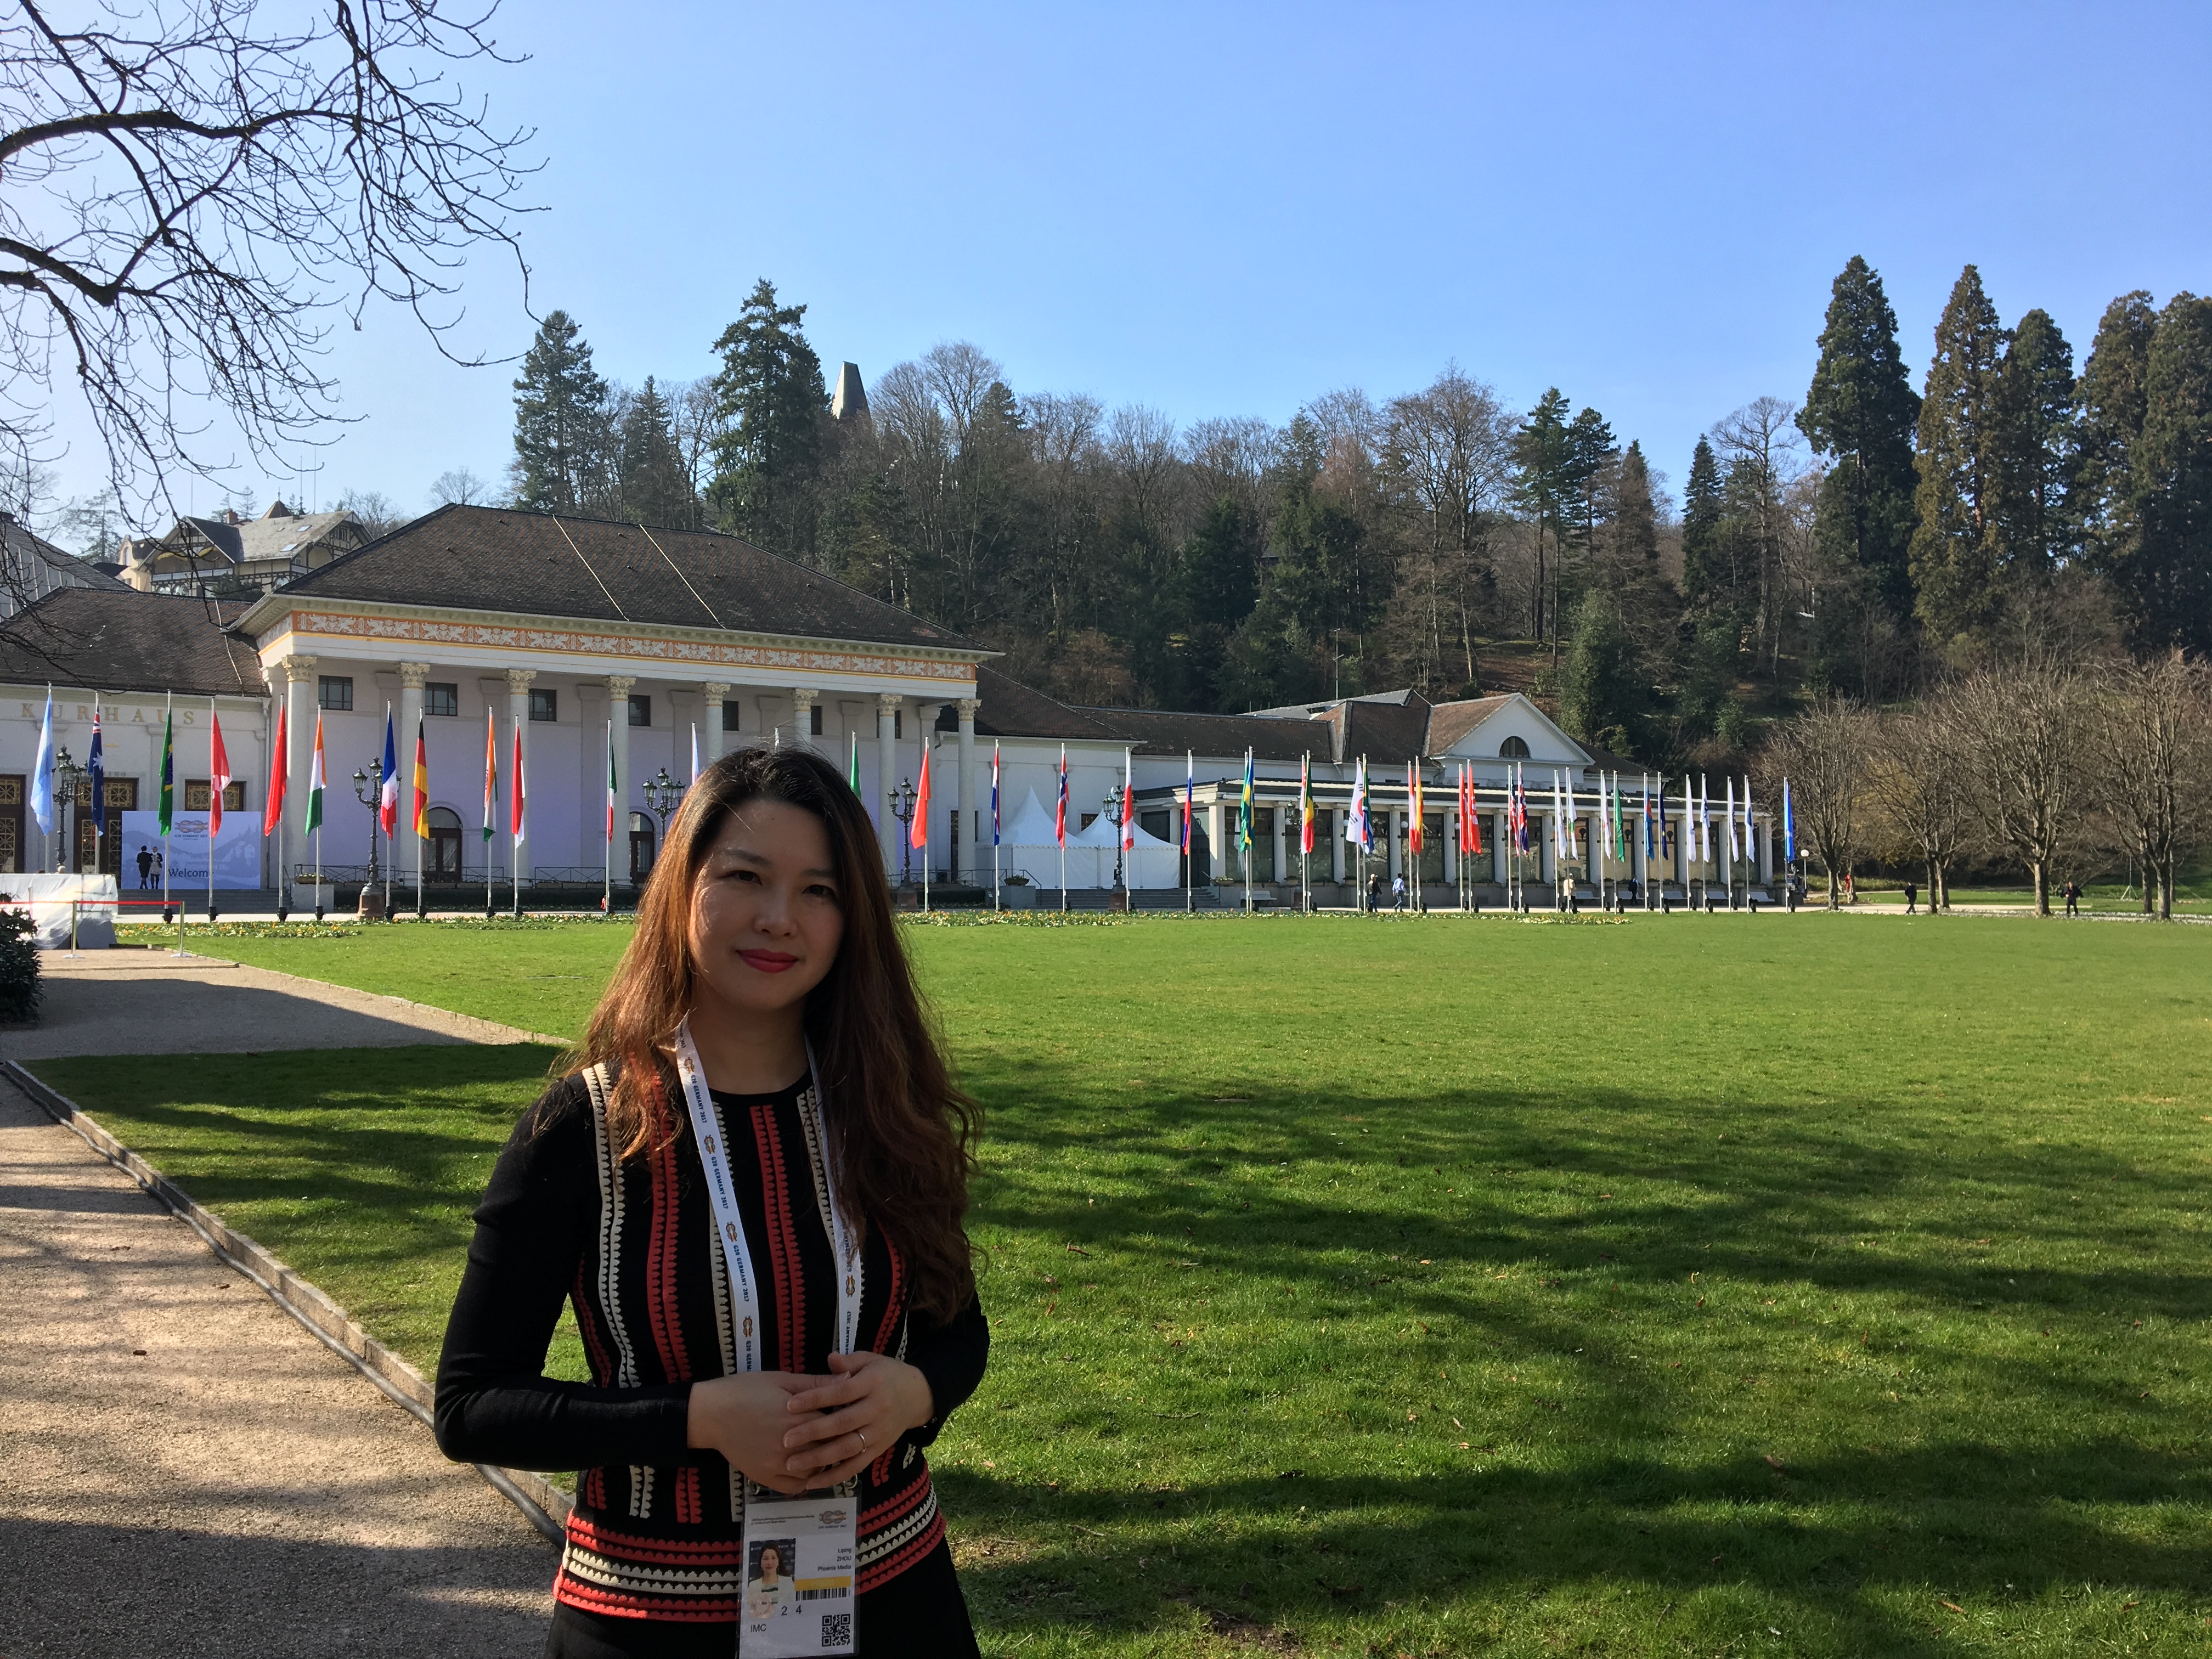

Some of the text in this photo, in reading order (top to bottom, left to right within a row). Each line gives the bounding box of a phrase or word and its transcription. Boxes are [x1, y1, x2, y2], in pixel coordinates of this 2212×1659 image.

[21, 703, 194, 724] KURHAUS
[168, 868, 214, 877] Welcom
[693, 1085, 704, 1110] GERMANY
[714, 1168, 725, 1195] GERMANY
[736, 1257, 747, 1286] GERMANY
[781, 1605, 802, 1616] 2 4
[751, 1623, 766, 1633] IMC
